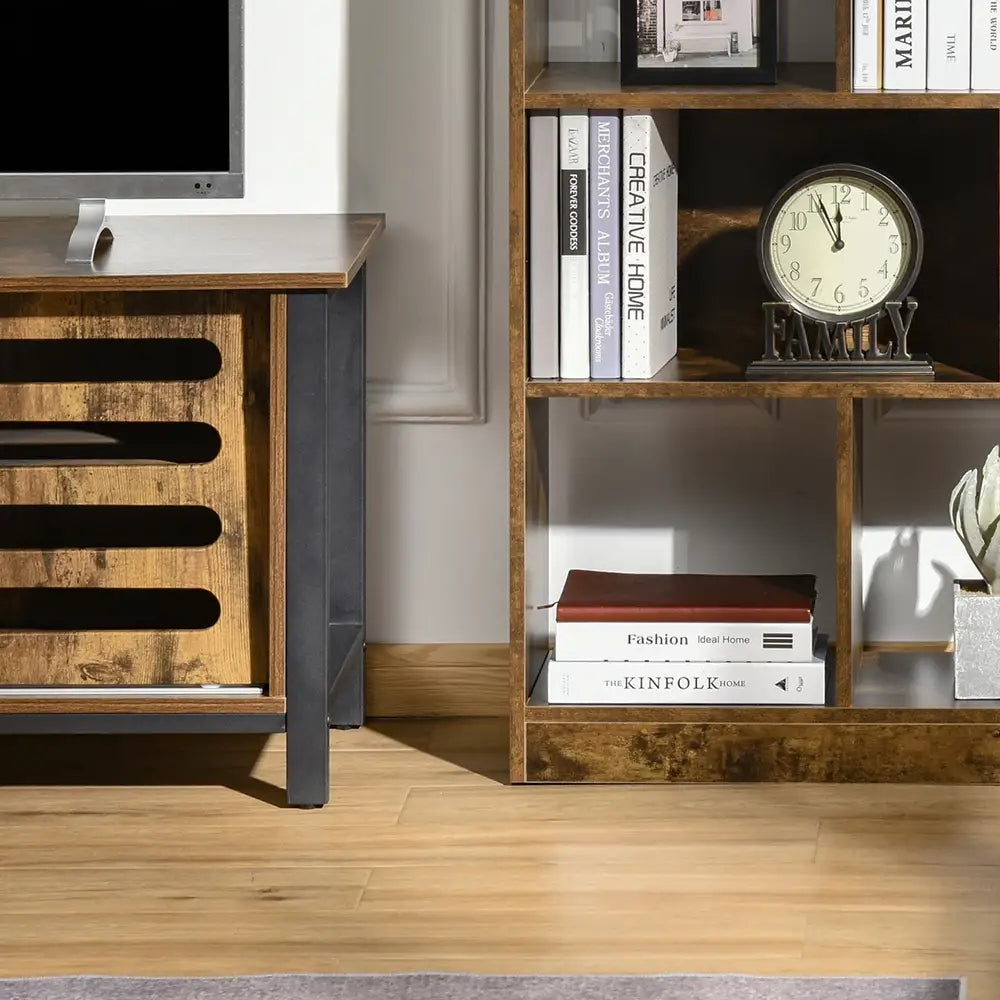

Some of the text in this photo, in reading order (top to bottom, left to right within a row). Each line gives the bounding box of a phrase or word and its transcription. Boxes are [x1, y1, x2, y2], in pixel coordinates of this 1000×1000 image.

[989, 16, 998, 51] WORLD
[946, 32, 957, 63] TIME
[596, 121, 611, 285] MERCHANTS ALBUM
[831, 184, 852, 205] 12
[861, 192, 870, 212] 1
[569, 174, 578, 251] FOREVER GODDESS
[789, 212, 808, 231] 10
[878, 207, 890, 226] 2
[627, 152, 646, 321] CREATIVE HOME
[780, 234, 792, 254] 9
[889, 234, 900, 254] 3
[790, 261, 801, 280] 8
[878, 260, 889, 280] 4
[811, 278, 823, 297] 7
[834, 283, 844, 304] 6
[858, 278, 870, 298] 5
[594, 316, 604, 363] Cloakrooms
[762, 301, 918, 360] FAMILY
[627, 633, 750, 646] Fashion Ideal Home
[624, 676, 720, 690] KINFOLK
[719, 680, 746, 688] HOME
